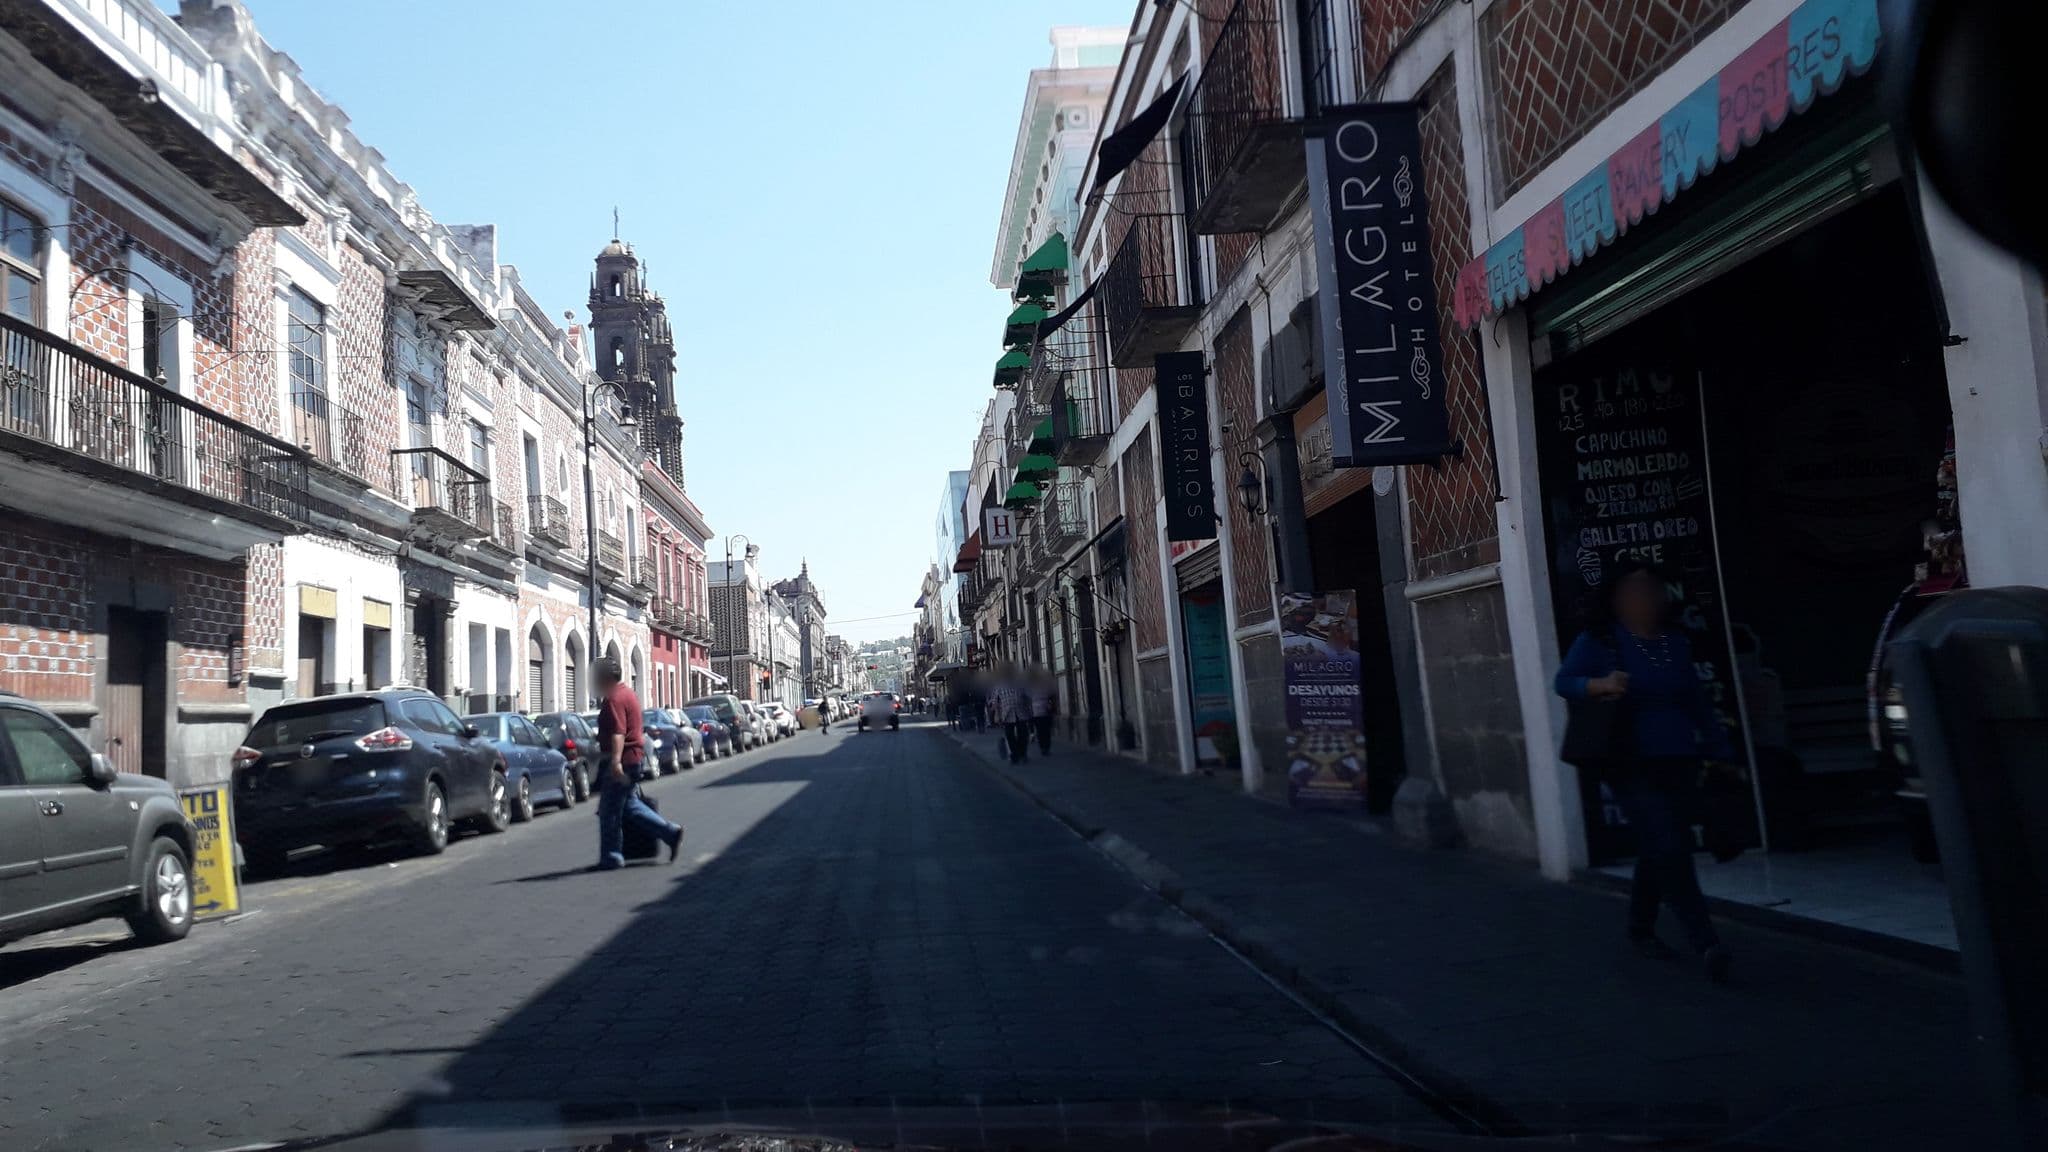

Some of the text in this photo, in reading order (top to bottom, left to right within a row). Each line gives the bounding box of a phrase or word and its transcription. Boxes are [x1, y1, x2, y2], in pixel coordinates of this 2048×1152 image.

[1464, 249, 1526, 304] PASTELES
[1613, 120, 1690, 208] BAKERY
[1720, 16, 1840, 122] POSTRES
[1336, 120, 1404, 443] MILAGRO
[1401, 214, 1424, 342] HOTEL
[1178, 385, 1203, 518] BARRIOS
[1575, 425, 1668, 453] CAPUCHINO
[1577, 451, 1689, 480] MARMOLEADO
[1585, 481, 1637, 504] QUESO
[993, 515, 1010, 537] H
[1580, 515, 1698, 548] GALLETA OREO
[1293, 661, 1353, 672] MILAGRO
[1287, 684, 1360, 696] DESAYUNOS
